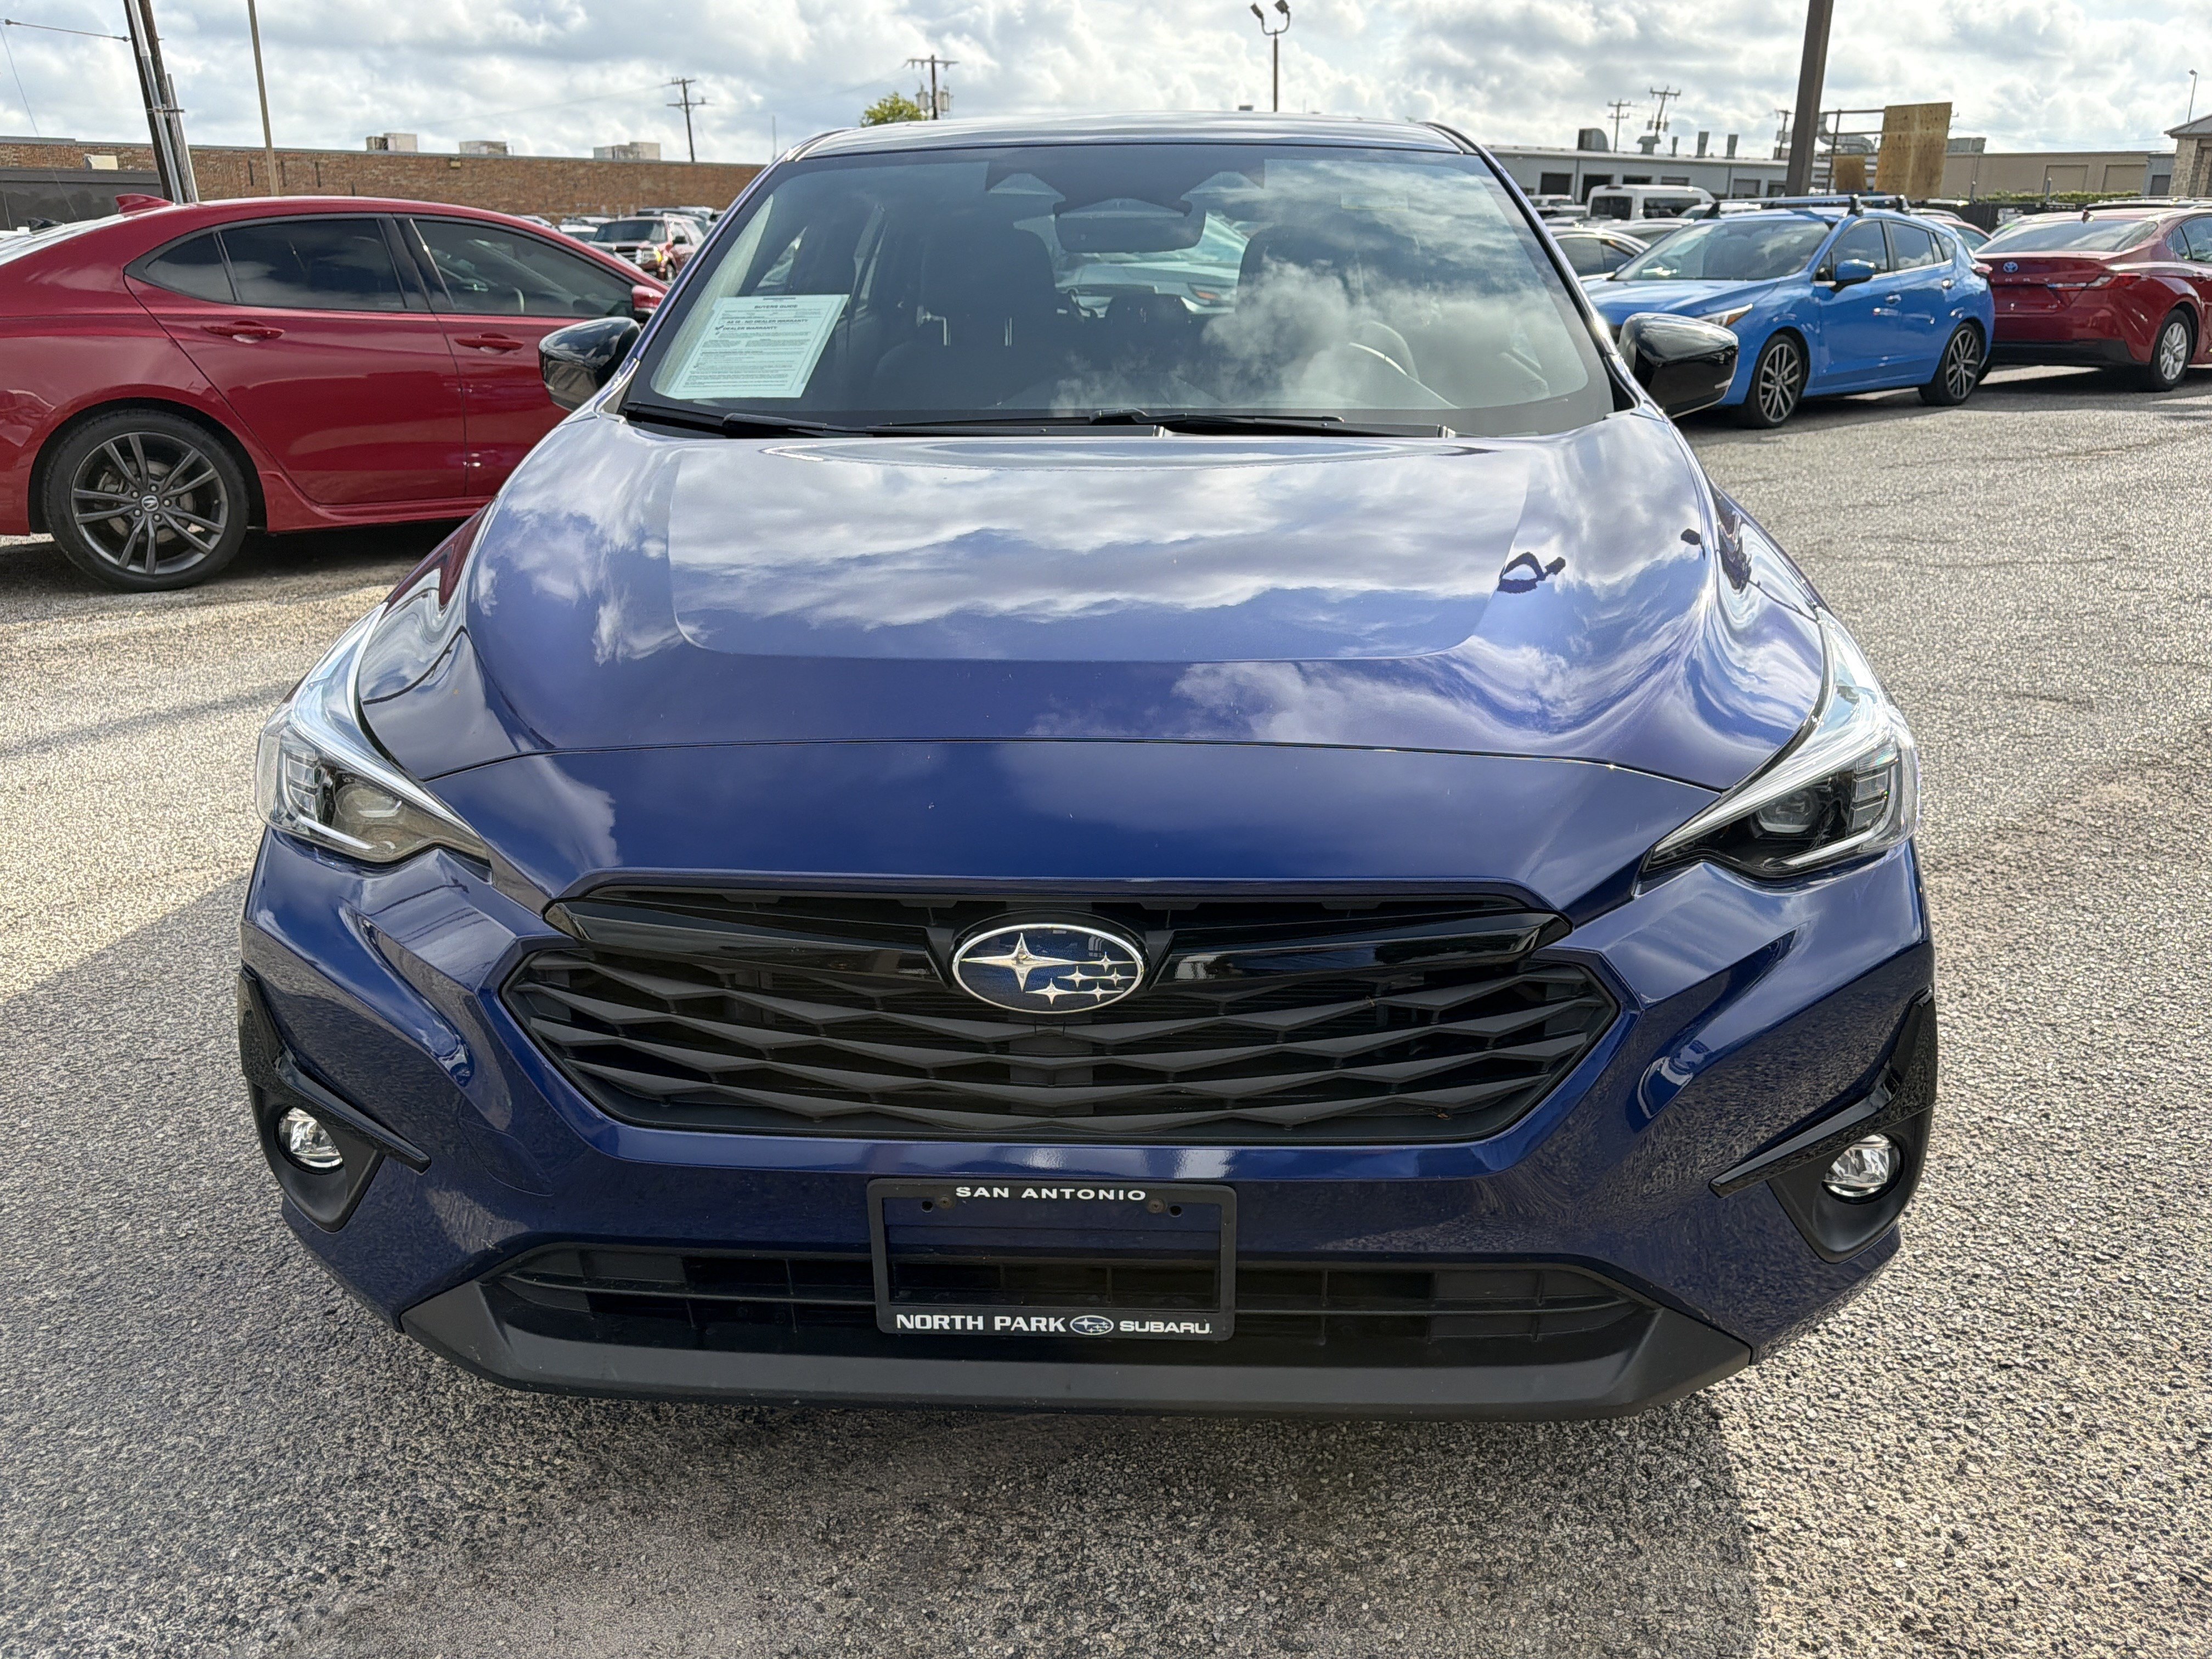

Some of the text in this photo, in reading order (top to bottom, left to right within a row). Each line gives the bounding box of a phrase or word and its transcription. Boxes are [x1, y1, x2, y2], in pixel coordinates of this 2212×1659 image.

[956, 1187, 1146, 1200] SAN ANTONIO
[896, 1314, 984, 1330] NORTH
[994, 1316, 1066, 1332] PARK
